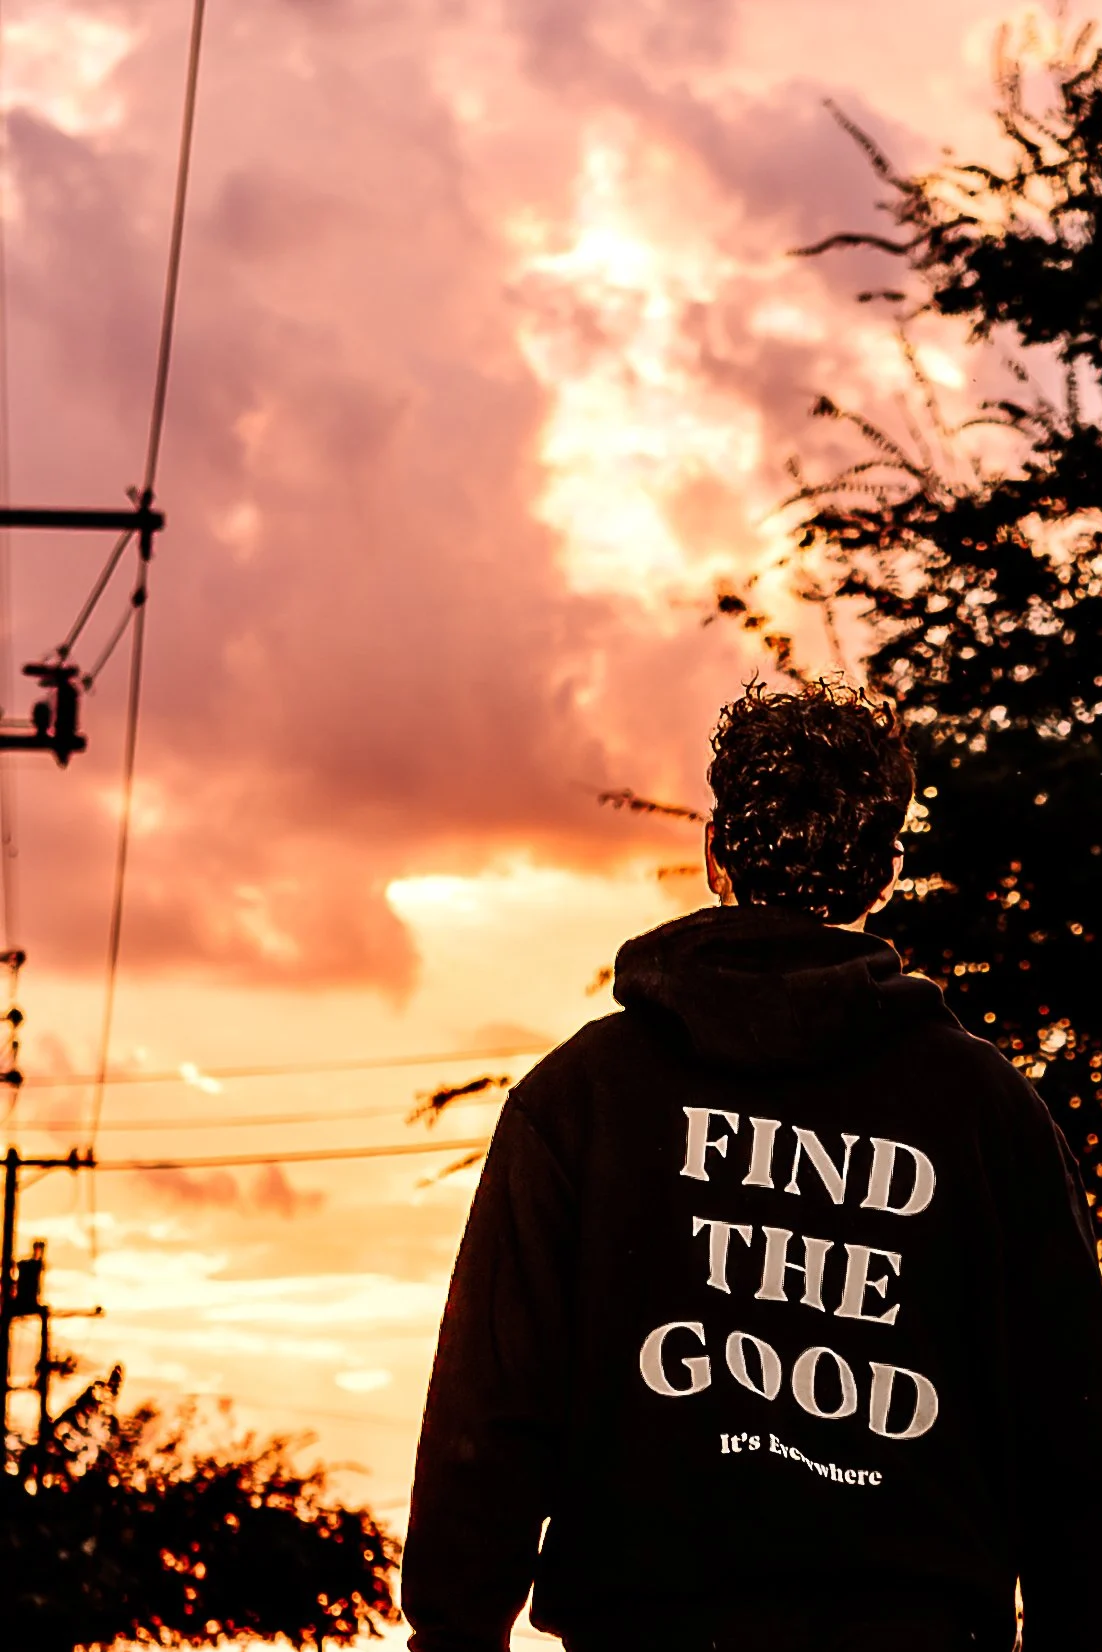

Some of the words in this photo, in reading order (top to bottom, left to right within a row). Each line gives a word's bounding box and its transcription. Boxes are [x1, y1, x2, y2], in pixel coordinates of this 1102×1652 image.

[680, 1106, 937, 1216] FIND
[692, 1216, 902, 1326] THE
[639, 1321, 939, 1440] GOOD
[719, 1432, 761, 1454] It's
